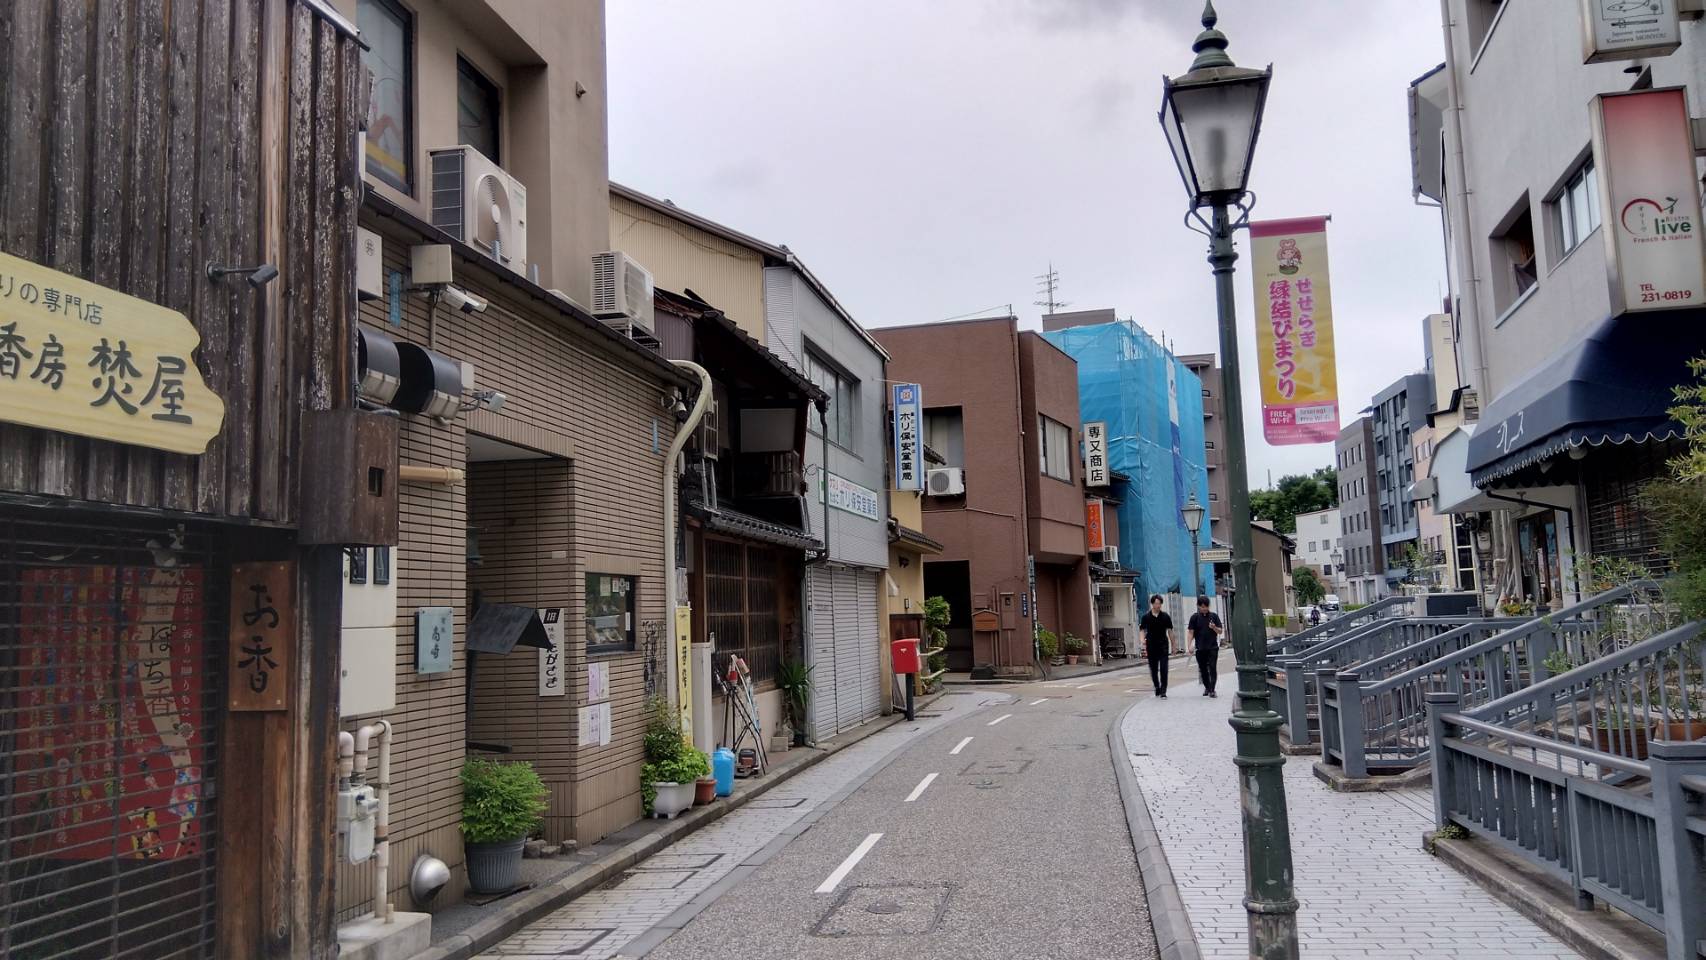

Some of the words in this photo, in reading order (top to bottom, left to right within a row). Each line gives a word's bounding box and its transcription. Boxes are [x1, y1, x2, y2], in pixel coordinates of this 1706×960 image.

[1295, 278, 1315, 348] せせらぎ
[1641, 290, 1692, 303] 231-0819
[1269, 280, 1296, 398] 縁結びまつり
[88, 338, 193, 425] 焚屋
[900, 412, 913, 481] ホリ保安堂薬局
[1088, 426, 1103, 482] 専又商店
[238, 583, 280, 693] お香
